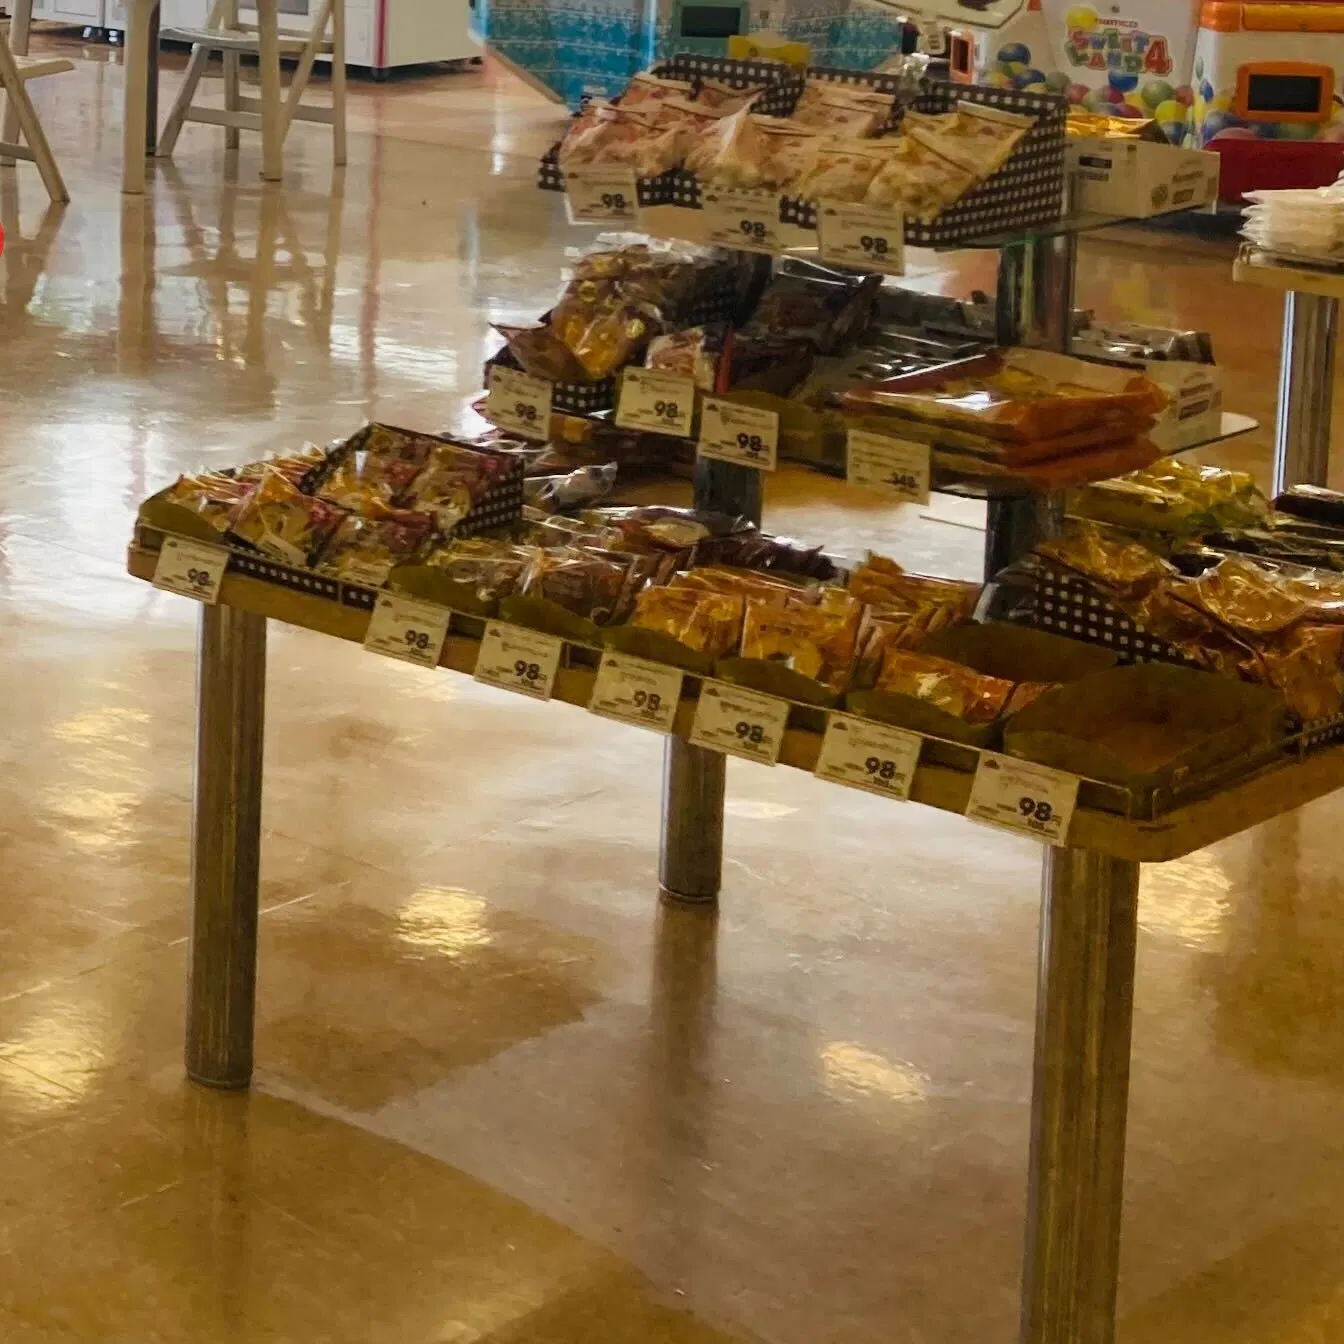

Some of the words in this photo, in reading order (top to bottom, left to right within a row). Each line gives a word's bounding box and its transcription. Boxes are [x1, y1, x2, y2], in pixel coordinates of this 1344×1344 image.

[740, 219, 767, 238] 98
[860, 234, 889, 254] 98
[515, 402, 538, 421] 98
[654, 400, 679, 418] 98
[736, 432, 764, 452] 98
[404, 629, 430, 649] 98
[514, 659, 541, 679] 98
[632, 689, 662, 711] 98
[735, 721, 764, 743] 98
[864, 755, 897, 780] 98
[1018, 795, 1053, 822] 98
